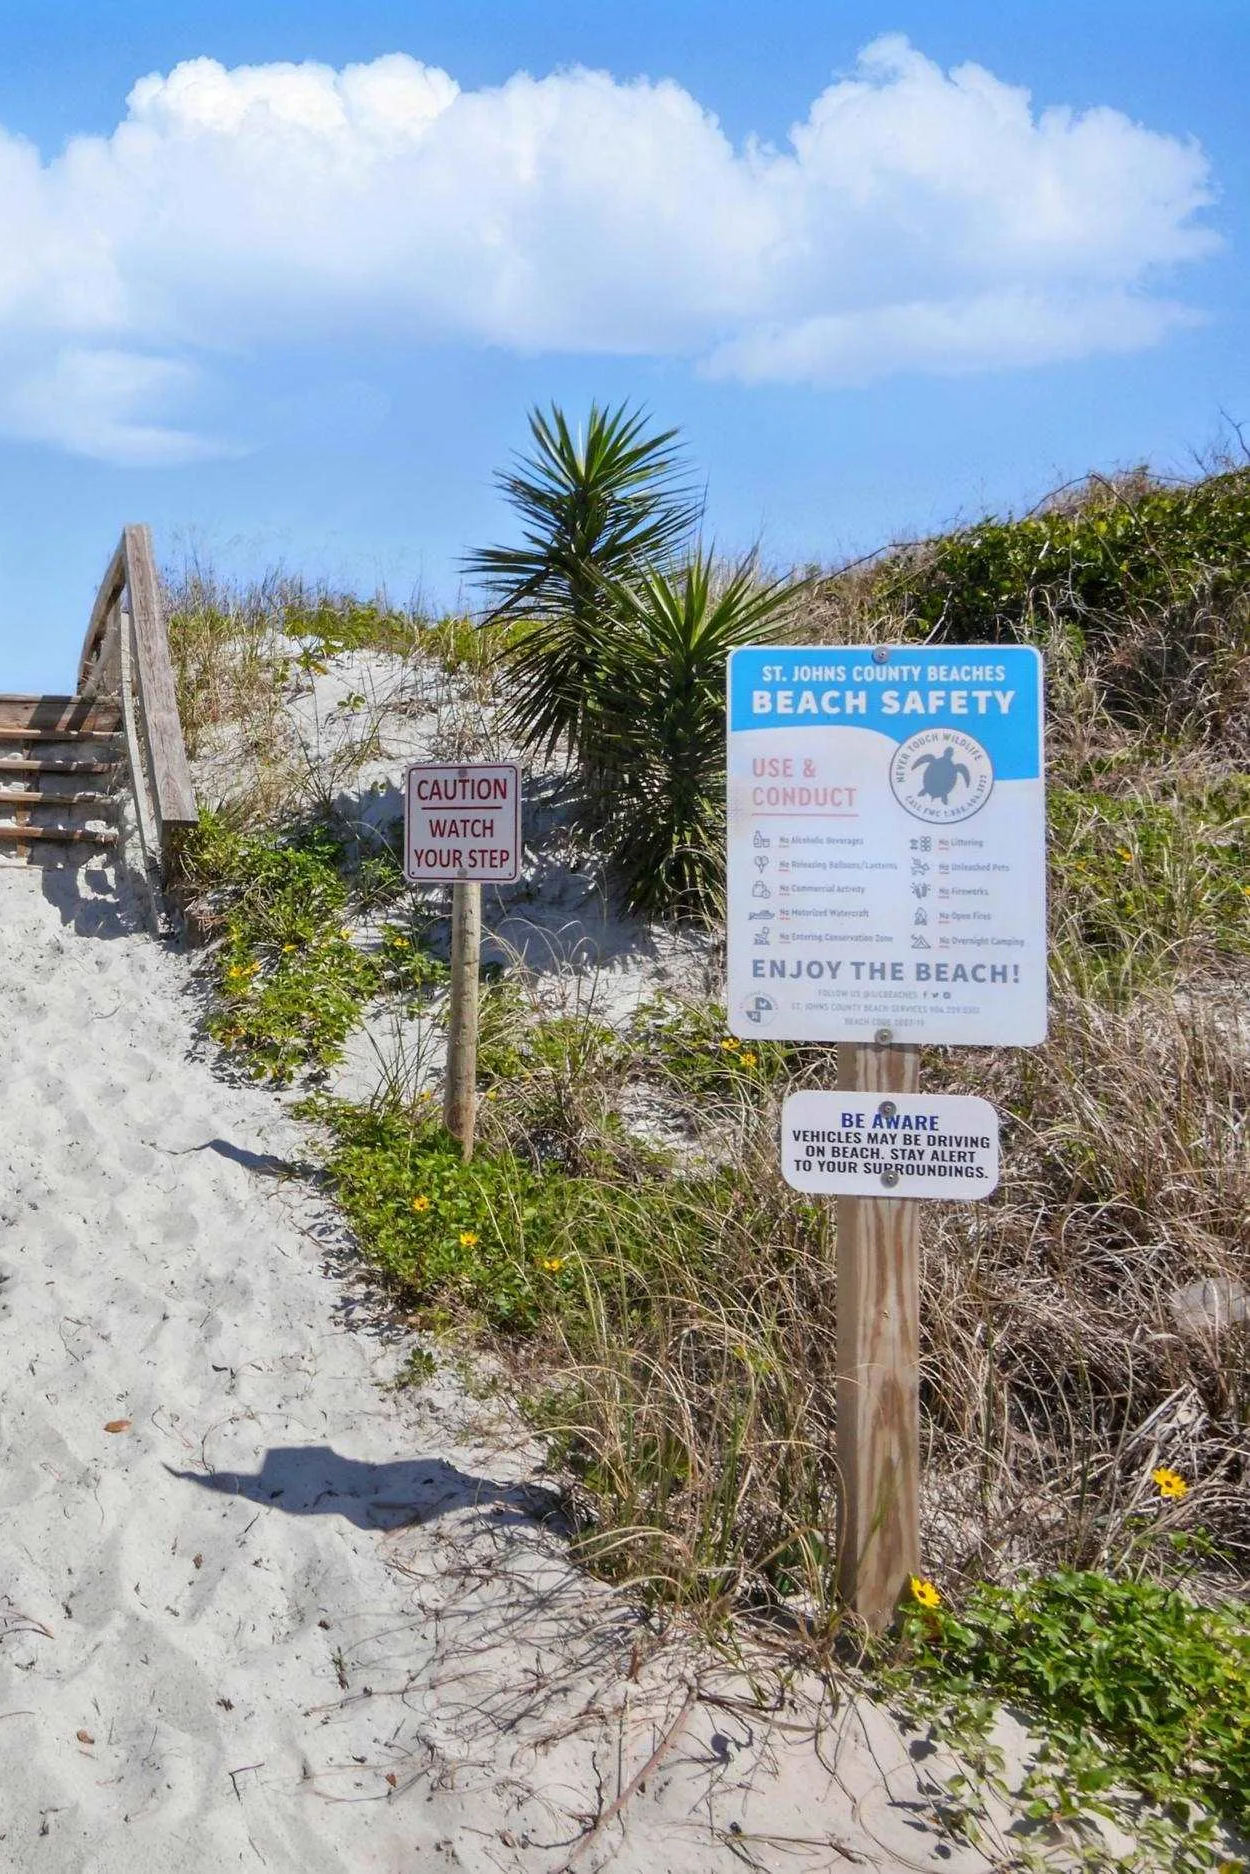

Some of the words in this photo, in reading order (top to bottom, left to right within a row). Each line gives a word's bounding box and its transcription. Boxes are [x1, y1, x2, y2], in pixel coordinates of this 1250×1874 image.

[762, 666, 787, 682] ST.
[792, 666, 847, 682] JOHNS
[853, 665, 921, 682] COUNTY
[927, 665, 1006, 682] BEACHES
[753, 690, 867, 714] BEACH
[881, 690, 1015, 714] SAFETY
[895, 753, 911, 783] NEVER
[908, 733, 939, 752] TOUCH
[943, 733, 983, 761] WILDLIFE
[753, 758, 794, 778] USE
[803, 758, 816, 778] &
[417, 778, 508, 801] CAUTION
[753, 787, 857, 807] CONDUCT
[429, 819, 494, 838] WATCH
[951, 839, 984, 848] Littering
[414, 849, 463, 868] YOUR
[468, 849, 510, 869] STEP
[752, 959, 842, 979] ENJOY
[850, 961, 904, 981] THE
[916, 963, 1019, 984] BEACH!
[841, 1112, 865, 1128] BE
[872, 1114, 939, 1131] AWARE
[793, 1130, 862, 1144] VEHICLES
[867, 1133, 899, 1145] MAY
[903, 1134, 921, 1146] BE
[927, 1135, 990, 1149] DRIVING
[805, 1145, 826, 1158] ON
[831, 1147, 884, 1160] BEACH.
[890, 1149, 925, 1161] STAY
[930, 1150, 977, 1163] ALERT
[794, 1160, 812, 1172] TO
[818, 1161, 857, 1174] YOUR
